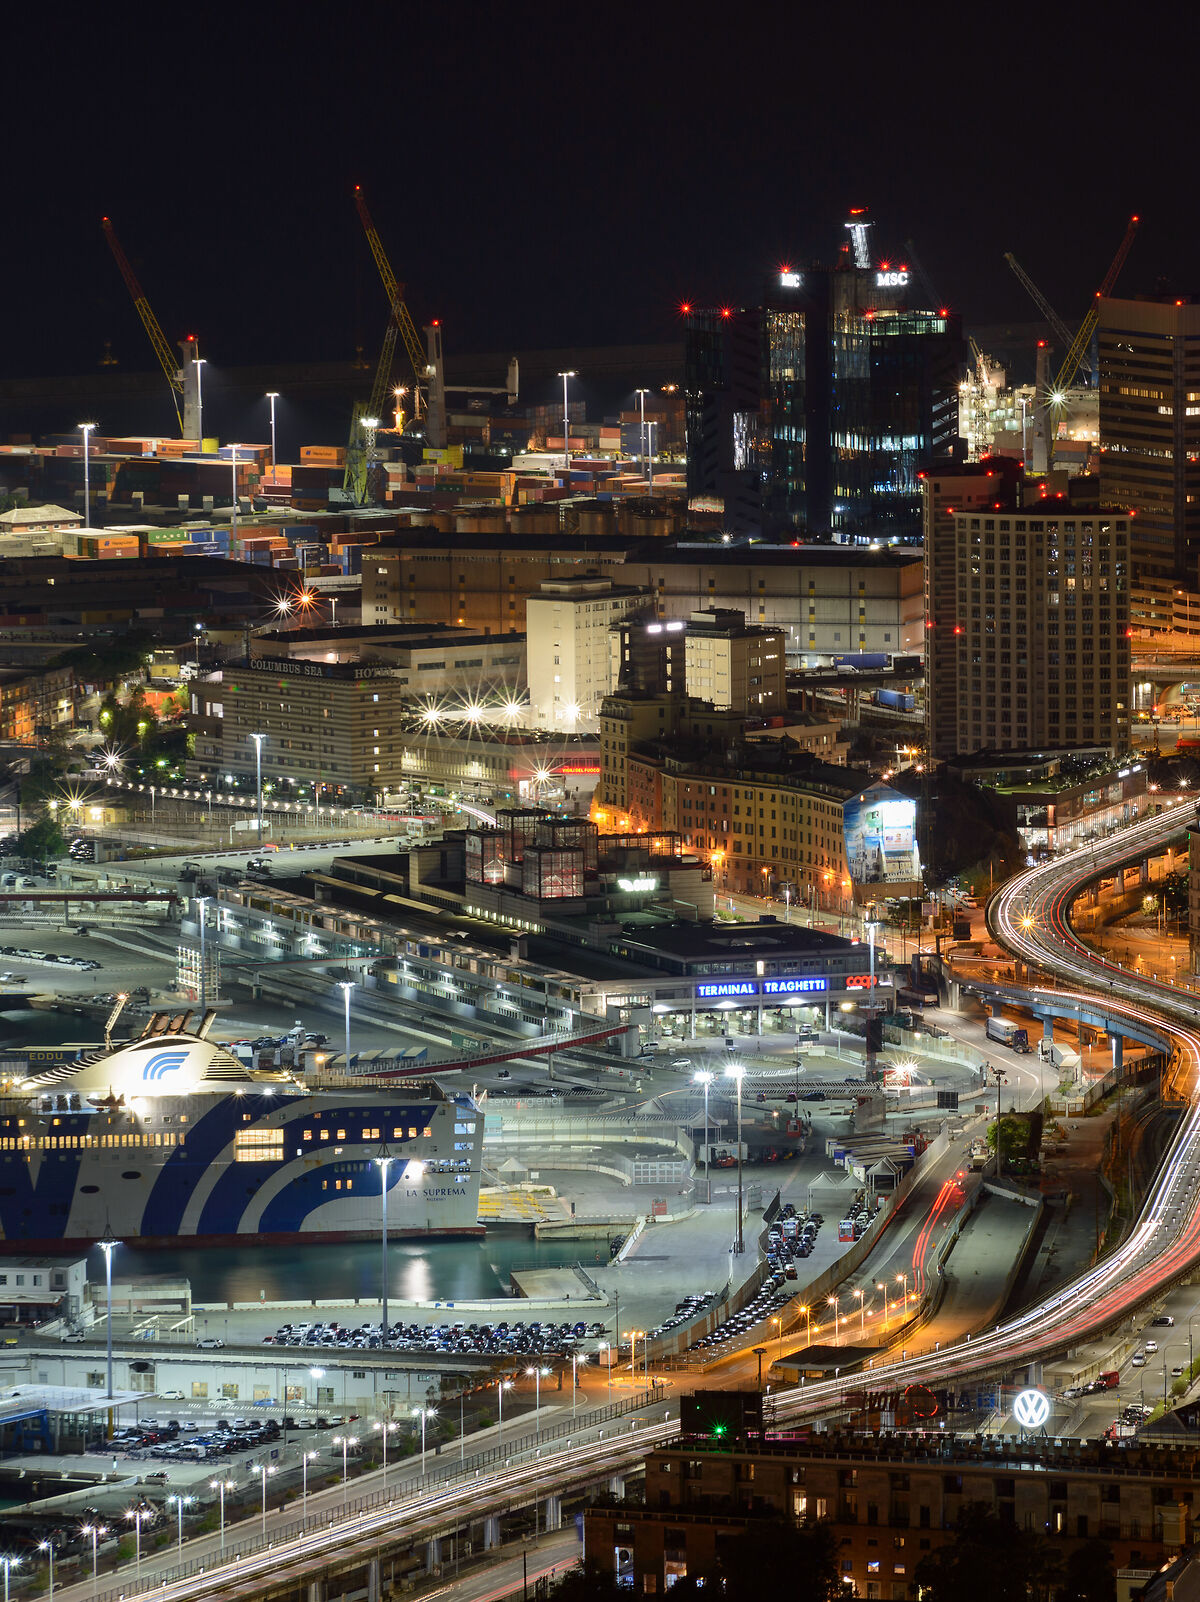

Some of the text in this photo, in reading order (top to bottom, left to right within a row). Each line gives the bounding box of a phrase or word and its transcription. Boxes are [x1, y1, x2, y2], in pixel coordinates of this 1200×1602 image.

[877, 273, 908, 286] MSC
[250, 659, 395, 679] COLUMBUS SEA HOTEL
[698, 979, 825, 996] TERMINAL TRAGHETTI
[846, 975, 877, 989] coop
[406, 1187, 467, 1197] LA SUPREMA
